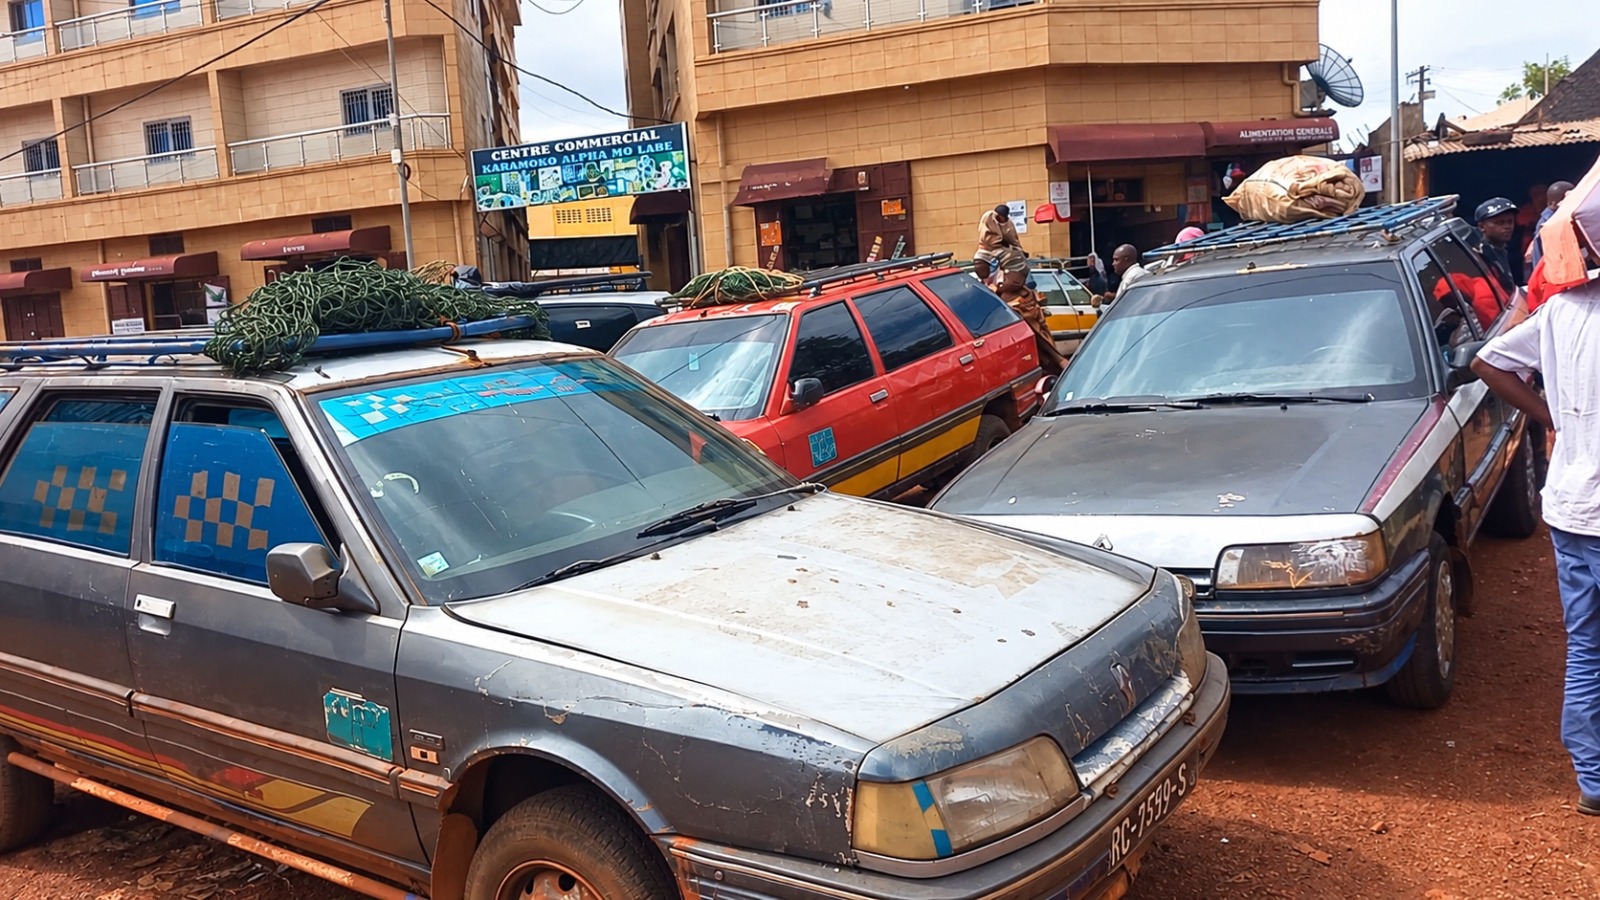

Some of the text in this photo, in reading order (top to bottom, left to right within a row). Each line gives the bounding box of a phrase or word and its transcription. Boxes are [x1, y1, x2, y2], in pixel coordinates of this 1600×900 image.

[481, 140, 673, 174] KARAMOKO ALPHA MO LABE
[491, 129, 660, 161] CENTRE COMMERCIAL
